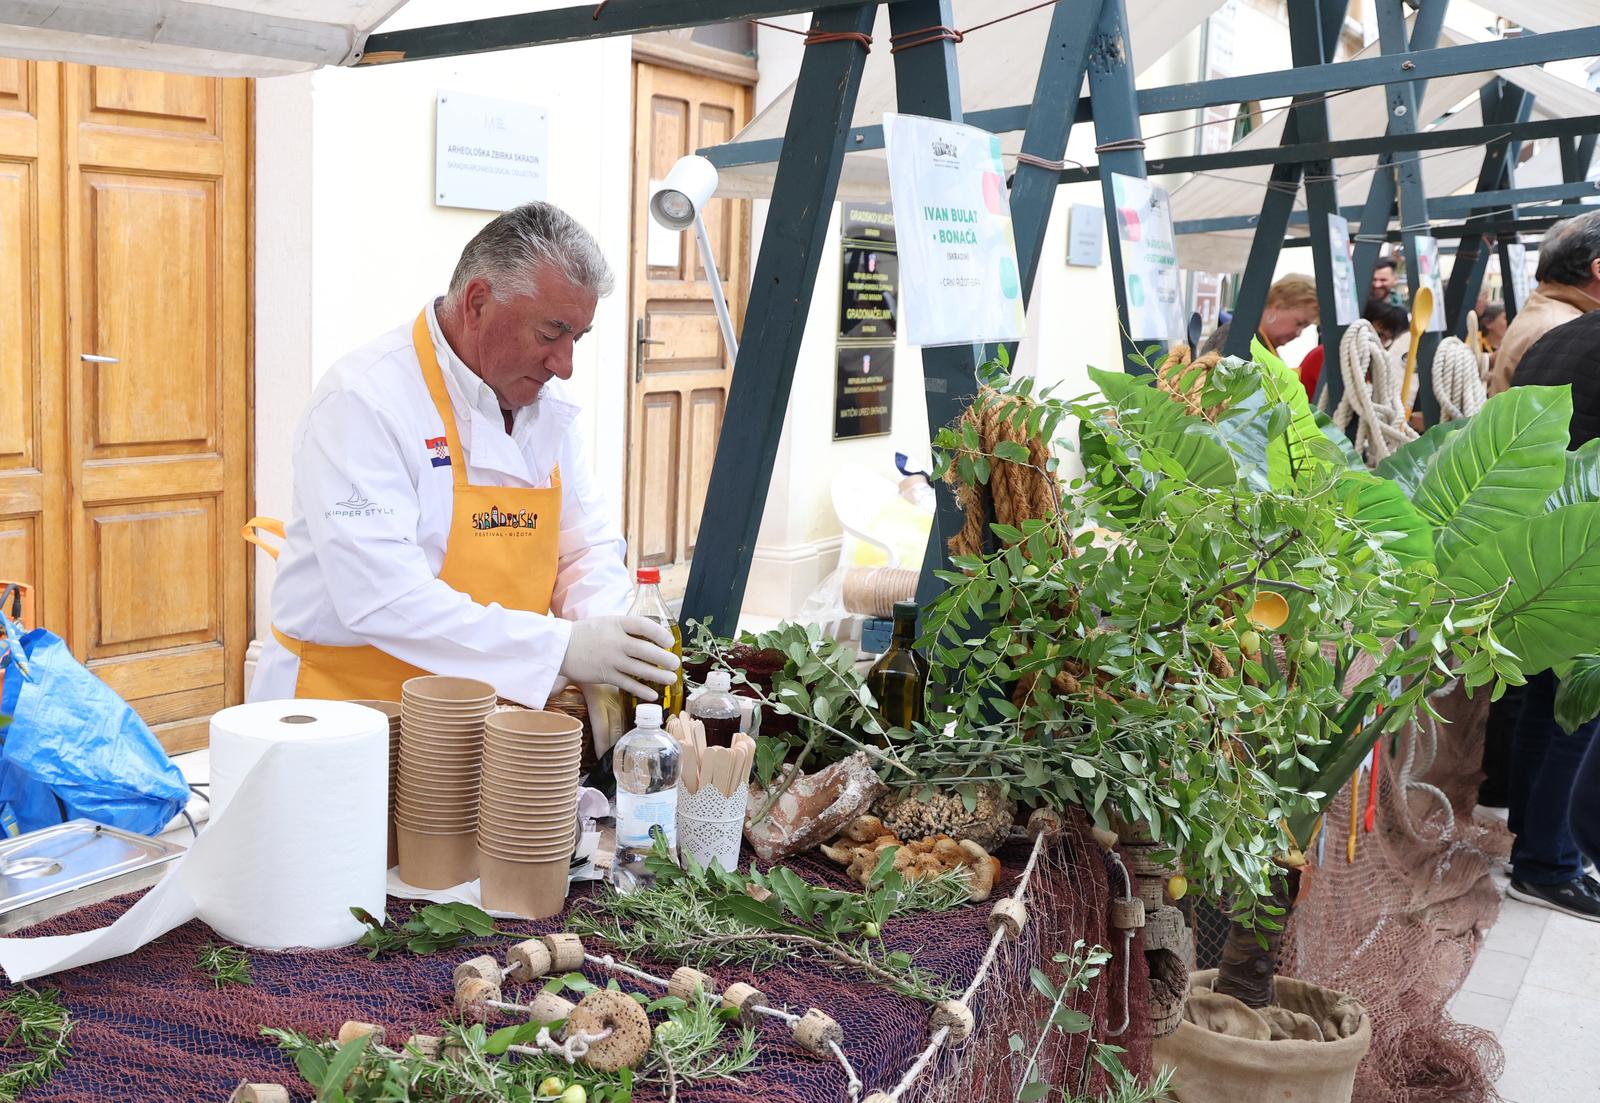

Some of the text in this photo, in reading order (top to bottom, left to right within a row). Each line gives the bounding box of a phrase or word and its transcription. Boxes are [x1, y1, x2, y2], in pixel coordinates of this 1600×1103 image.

[448, 144, 539, 164] ARHEOLOŠKA ZBIRKA SKRADIN
[924, 206, 978, 224] IVAN BULAT
